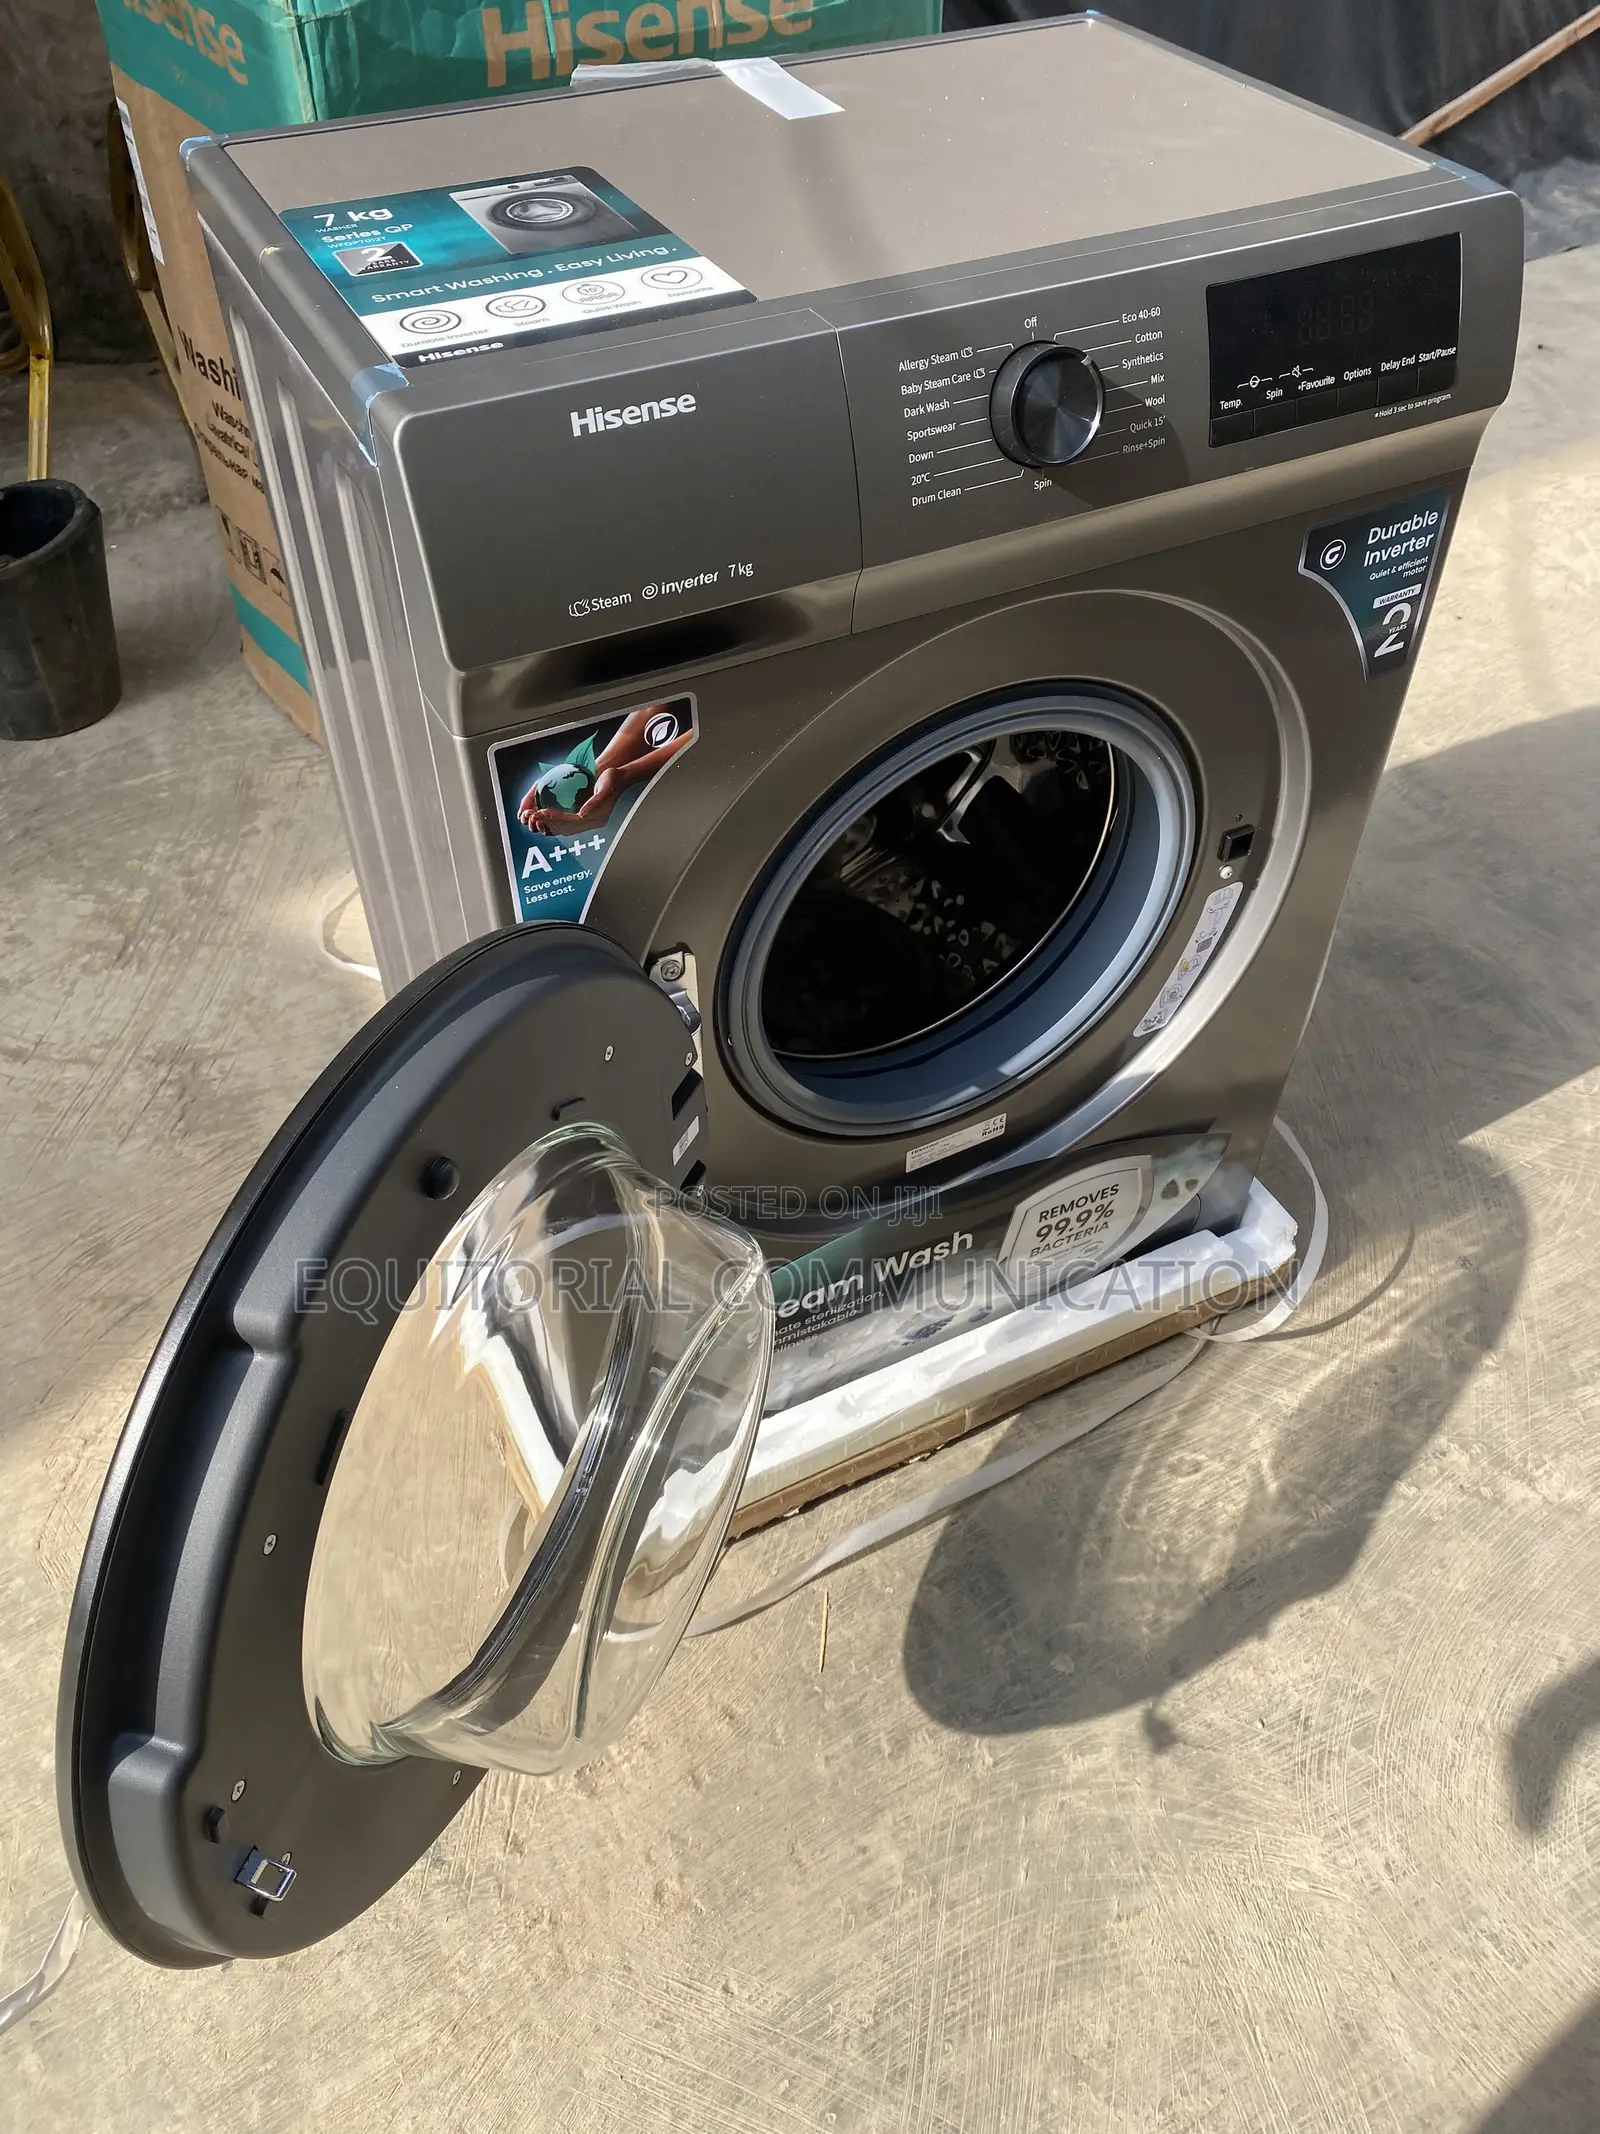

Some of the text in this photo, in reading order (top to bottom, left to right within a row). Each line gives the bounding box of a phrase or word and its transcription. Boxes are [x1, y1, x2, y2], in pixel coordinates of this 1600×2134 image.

[313, 208, 393, 227] 7 kg
[315, 223, 358, 233] WASHER
[321, 223, 413, 243] Series QP
[360, 247, 392, 262] 2
[357, 260, 410, 271] WARRANTY
[371, 245, 670, 303] Smart Washing Easy Living
[667, 286, 714, 298] Favourite
[582, 300, 642, 314] Quick Wash
[1121, 306, 1161, 324] Eco 40-60
[513, 317, 550, 328] Steam
[1024, 315, 1038, 329] Off
[401, 328, 489, 348] Durable Inverter
[1135, 329, 1163, 343] Cotton
[418, 342, 505, 363] Hisense
[899, 350, 959, 373] Allergy Steam
[1122, 351, 1164, 370] Synthetics
[901, 371, 972, 396] Baby Steam Care
[1150, 373, 1165, 385] Mix
[1219, 398, 1243, 412] Temp.
[1265, 387, 1283, 401] Spin
[1343, 365, 1372, 382] Options
[1380, 358, 1401, 373] Delay
[1401, 354, 1416, 367] End
[1418, 345, 1457, 363] Start/Pause
[903, 399, 950, 418] Dark Wash
[1144, 393, 1166, 408] Wool
[1379, 408, 1393, 418] Hold
[1398, 405, 1408, 413] sec
[1414, 400, 1427, 410] save
[570, 393, 697, 438] Hisense
[906, 420, 957, 442] Sportswear
[1129, 419, 1153, 434] Quick
[1122, 435, 1166, 455] Rinse+Spin
[908, 449, 934, 464] Down
[1033, 477, 1053, 491] Spin
[911, 486, 962, 507] Drum Clean
[1367, 510, 1439, 545] Durable
[1363, 534, 1434, 567] Inverter
[1369, 556, 1429, 581] Quiet & efficient
[1402, 565, 1427, 578] motor
[591, 562, 754, 611] Steam inverter 7 kg
[1379, 587, 1417, 605] WARRANTY
[1388, 623, 1408, 634] YEARS
[521, 834, 606, 880] A+++
[524, 869, 593, 895] Save energy.
[526, 884, 576, 905] Less cost.
[982, 1124, 1004, 1138] RoHS
[1038, 1183, 1120, 1223] REMOVES
[1035, 1200, 1115, 1244] 99.9%
[1029, 1221, 1110, 1259] BACTERIA
[775, 1273, 864, 1319] eam
[873, 1230, 973, 1283] Wash
[804, 1290, 885, 1325] sterilization,
